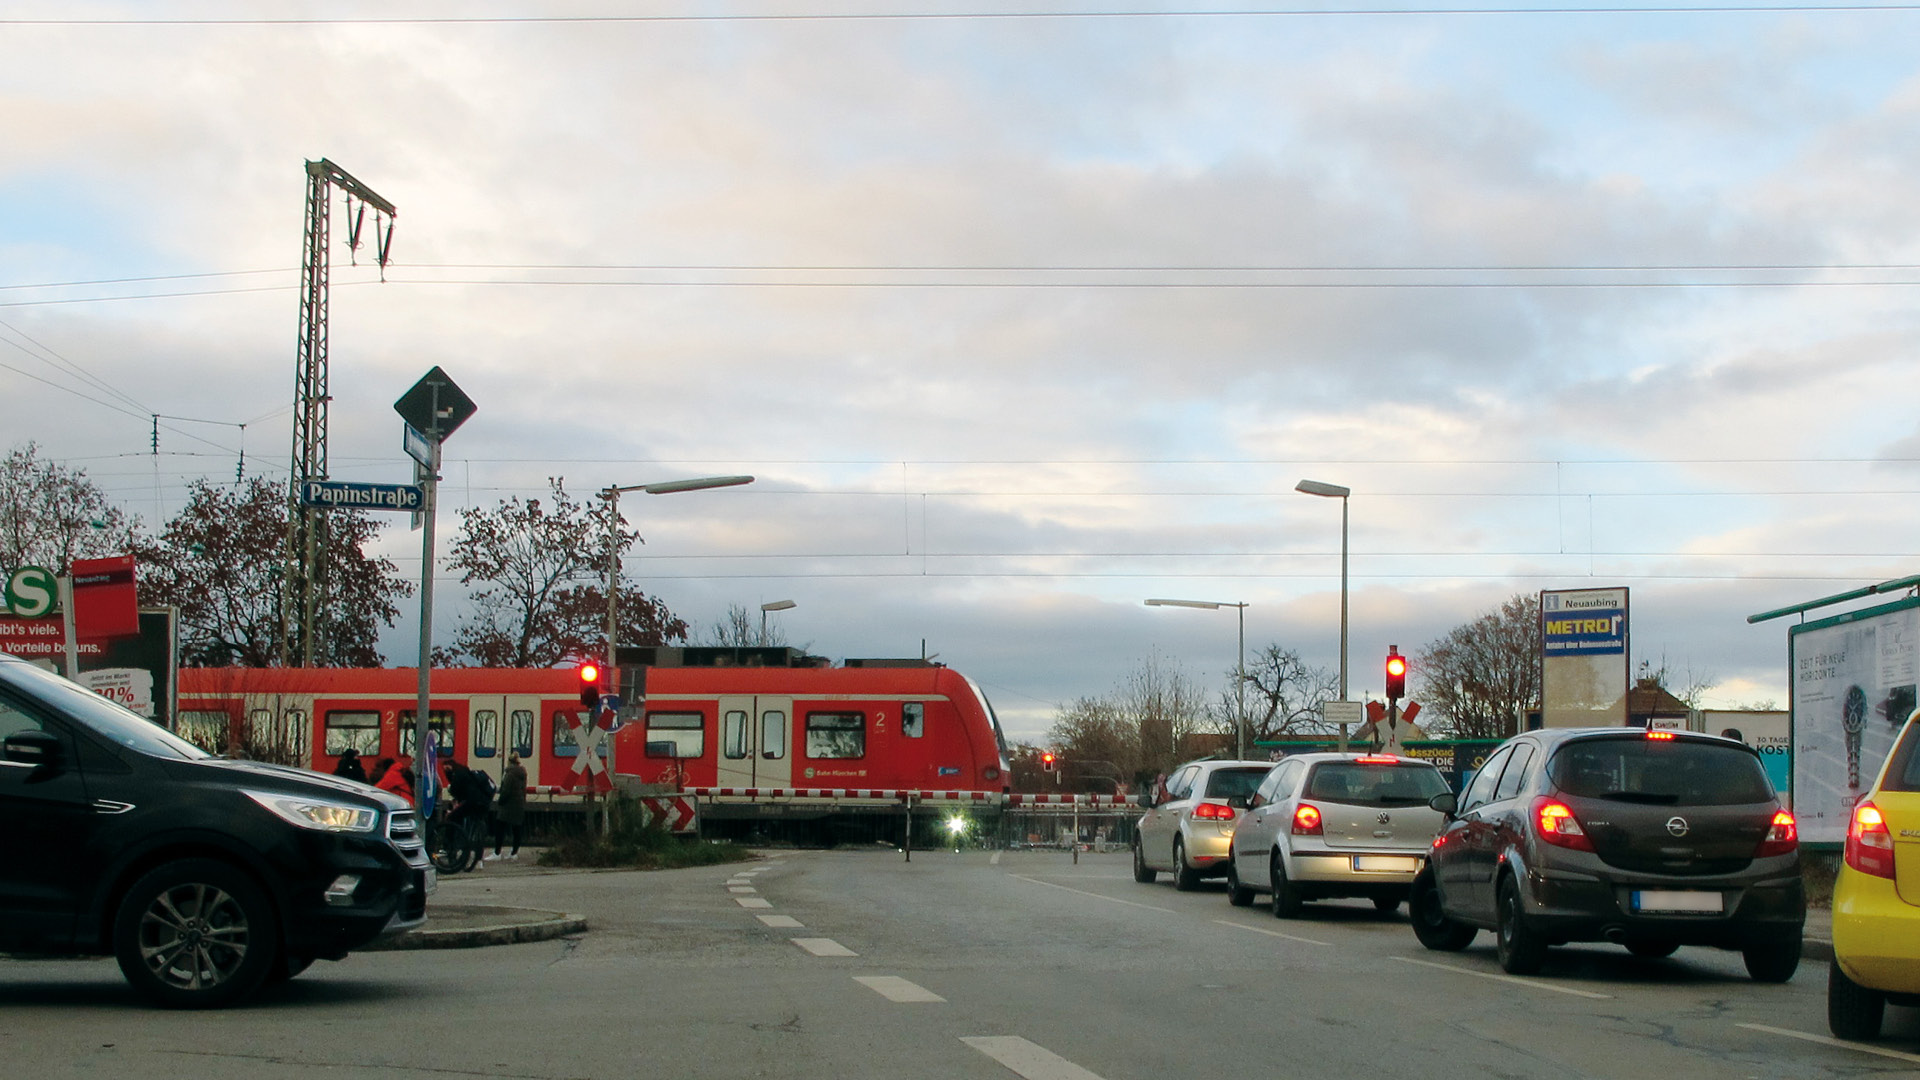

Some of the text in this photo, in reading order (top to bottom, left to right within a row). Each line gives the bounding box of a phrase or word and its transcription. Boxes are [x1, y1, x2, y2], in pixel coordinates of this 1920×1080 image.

[309, 484, 417, 508] Papinstraße
[12, 570, 50, 616] S
[1565, 599, 1618, 608] Neuaubing
[28, 624, 60, 635] viele.
[1546, 619, 1610, 635] METRO
[6, 642, 51, 653] Vorteile
[54, 642, 67, 653] be
[76, 643, 101, 653] uns.
[1801, 667, 1835, 681] HORIZONTE
[386, 711, 395, 725] 2
[875, 712, 886, 727] 2
[1404, 748, 1454, 757] ROSSZÜGIG
[1436, 757, 1454, 766] DIE
